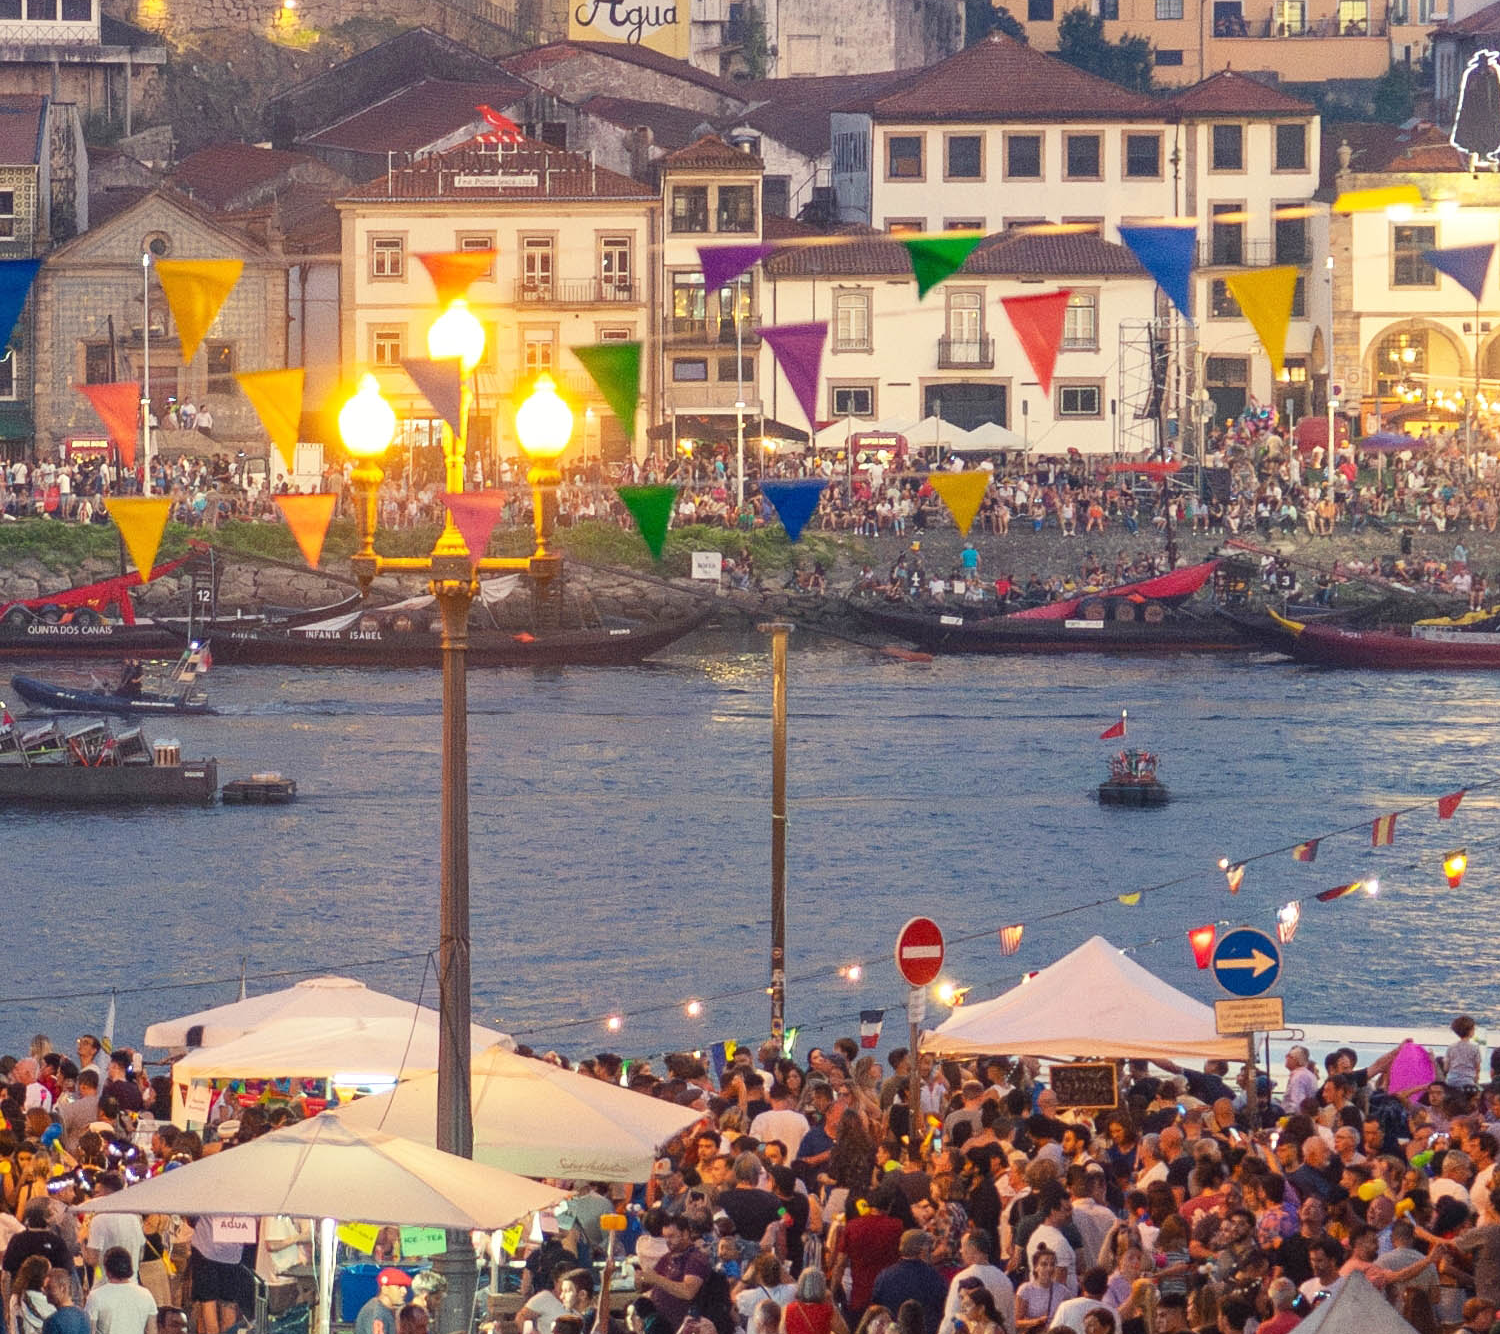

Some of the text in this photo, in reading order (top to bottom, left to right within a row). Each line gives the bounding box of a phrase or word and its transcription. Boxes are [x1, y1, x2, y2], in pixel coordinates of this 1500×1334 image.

[196, 589, 210, 602] 12
[27, 625, 113, 635] QUINTA DOS CANAIS
[305, 630, 383, 641] INFANTA ISABEL
